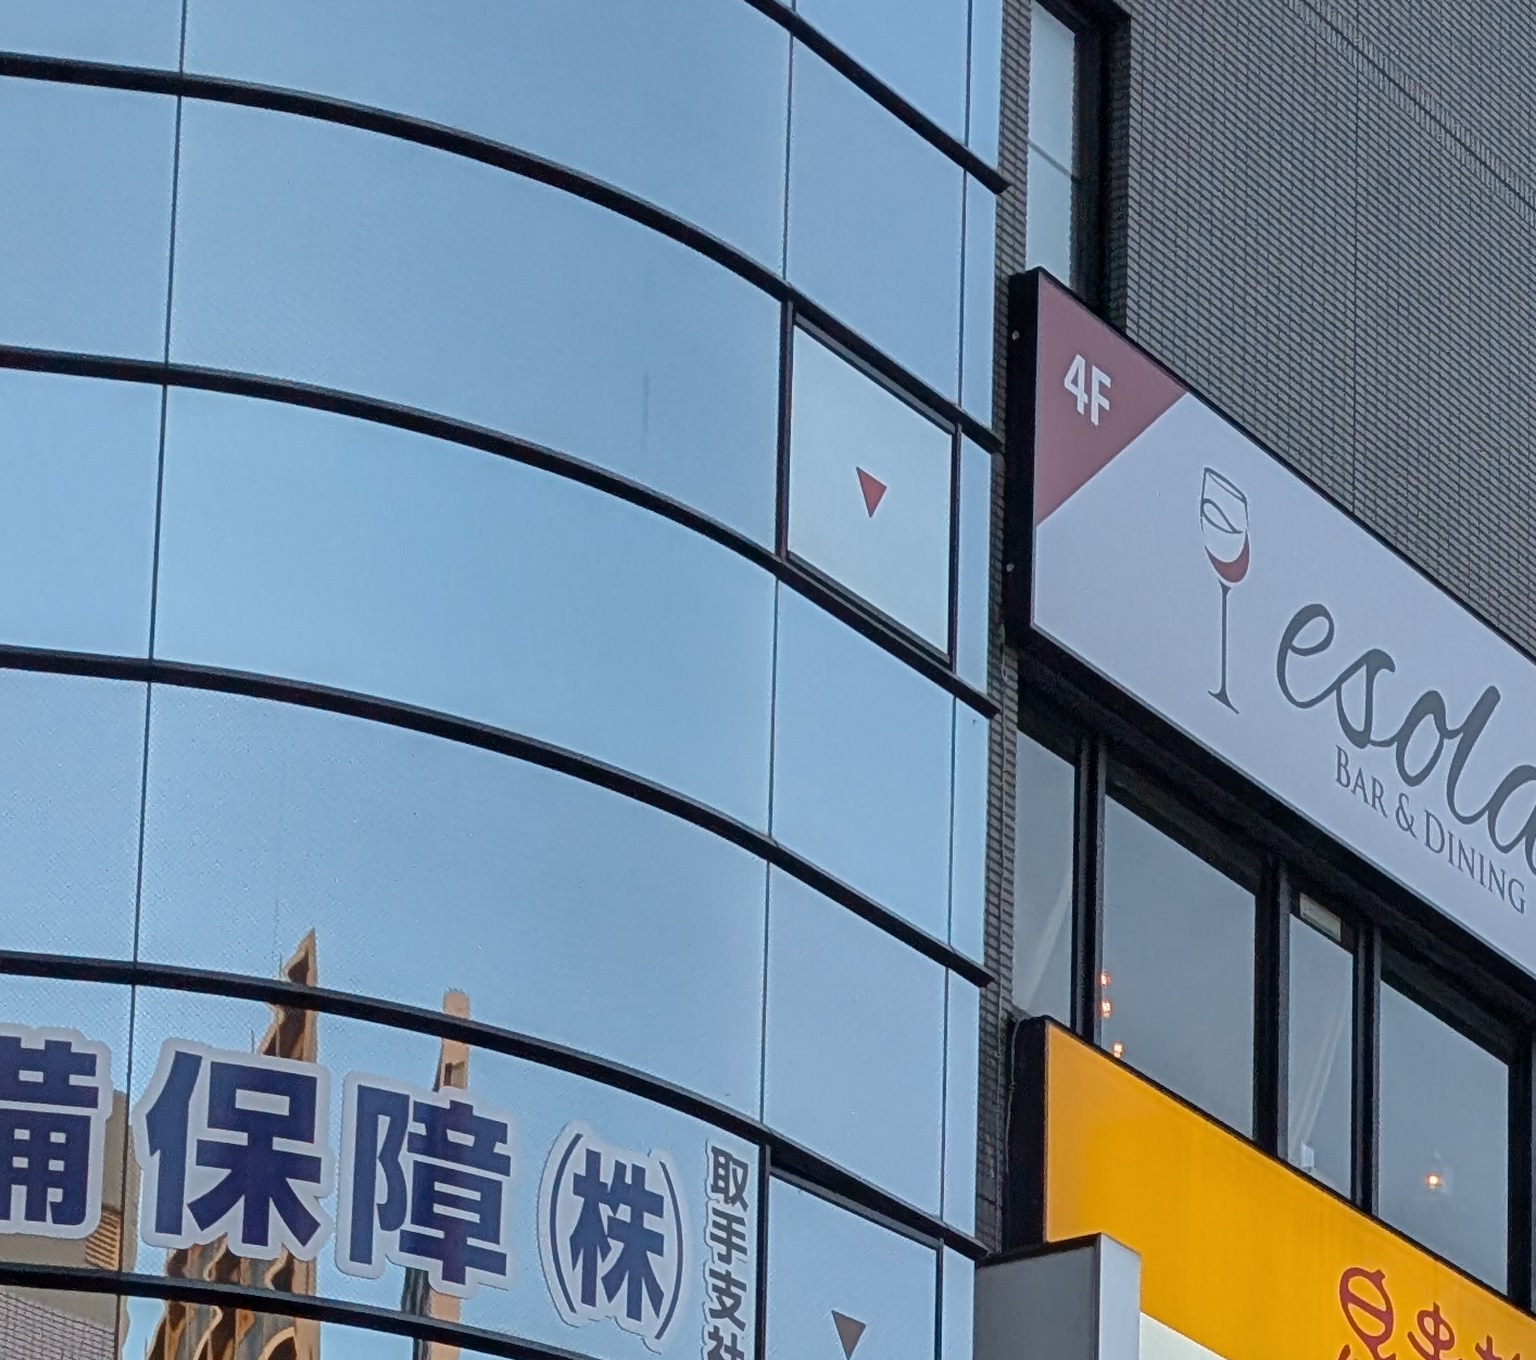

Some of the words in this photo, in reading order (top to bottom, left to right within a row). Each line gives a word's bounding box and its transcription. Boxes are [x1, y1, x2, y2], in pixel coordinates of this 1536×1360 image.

[1064, 353, 1111, 426] 4F
[1336, 744, 1388, 818] BAR
[1395, 792, 1418, 839] &
[1424, 809, 1526, 914] DINING
